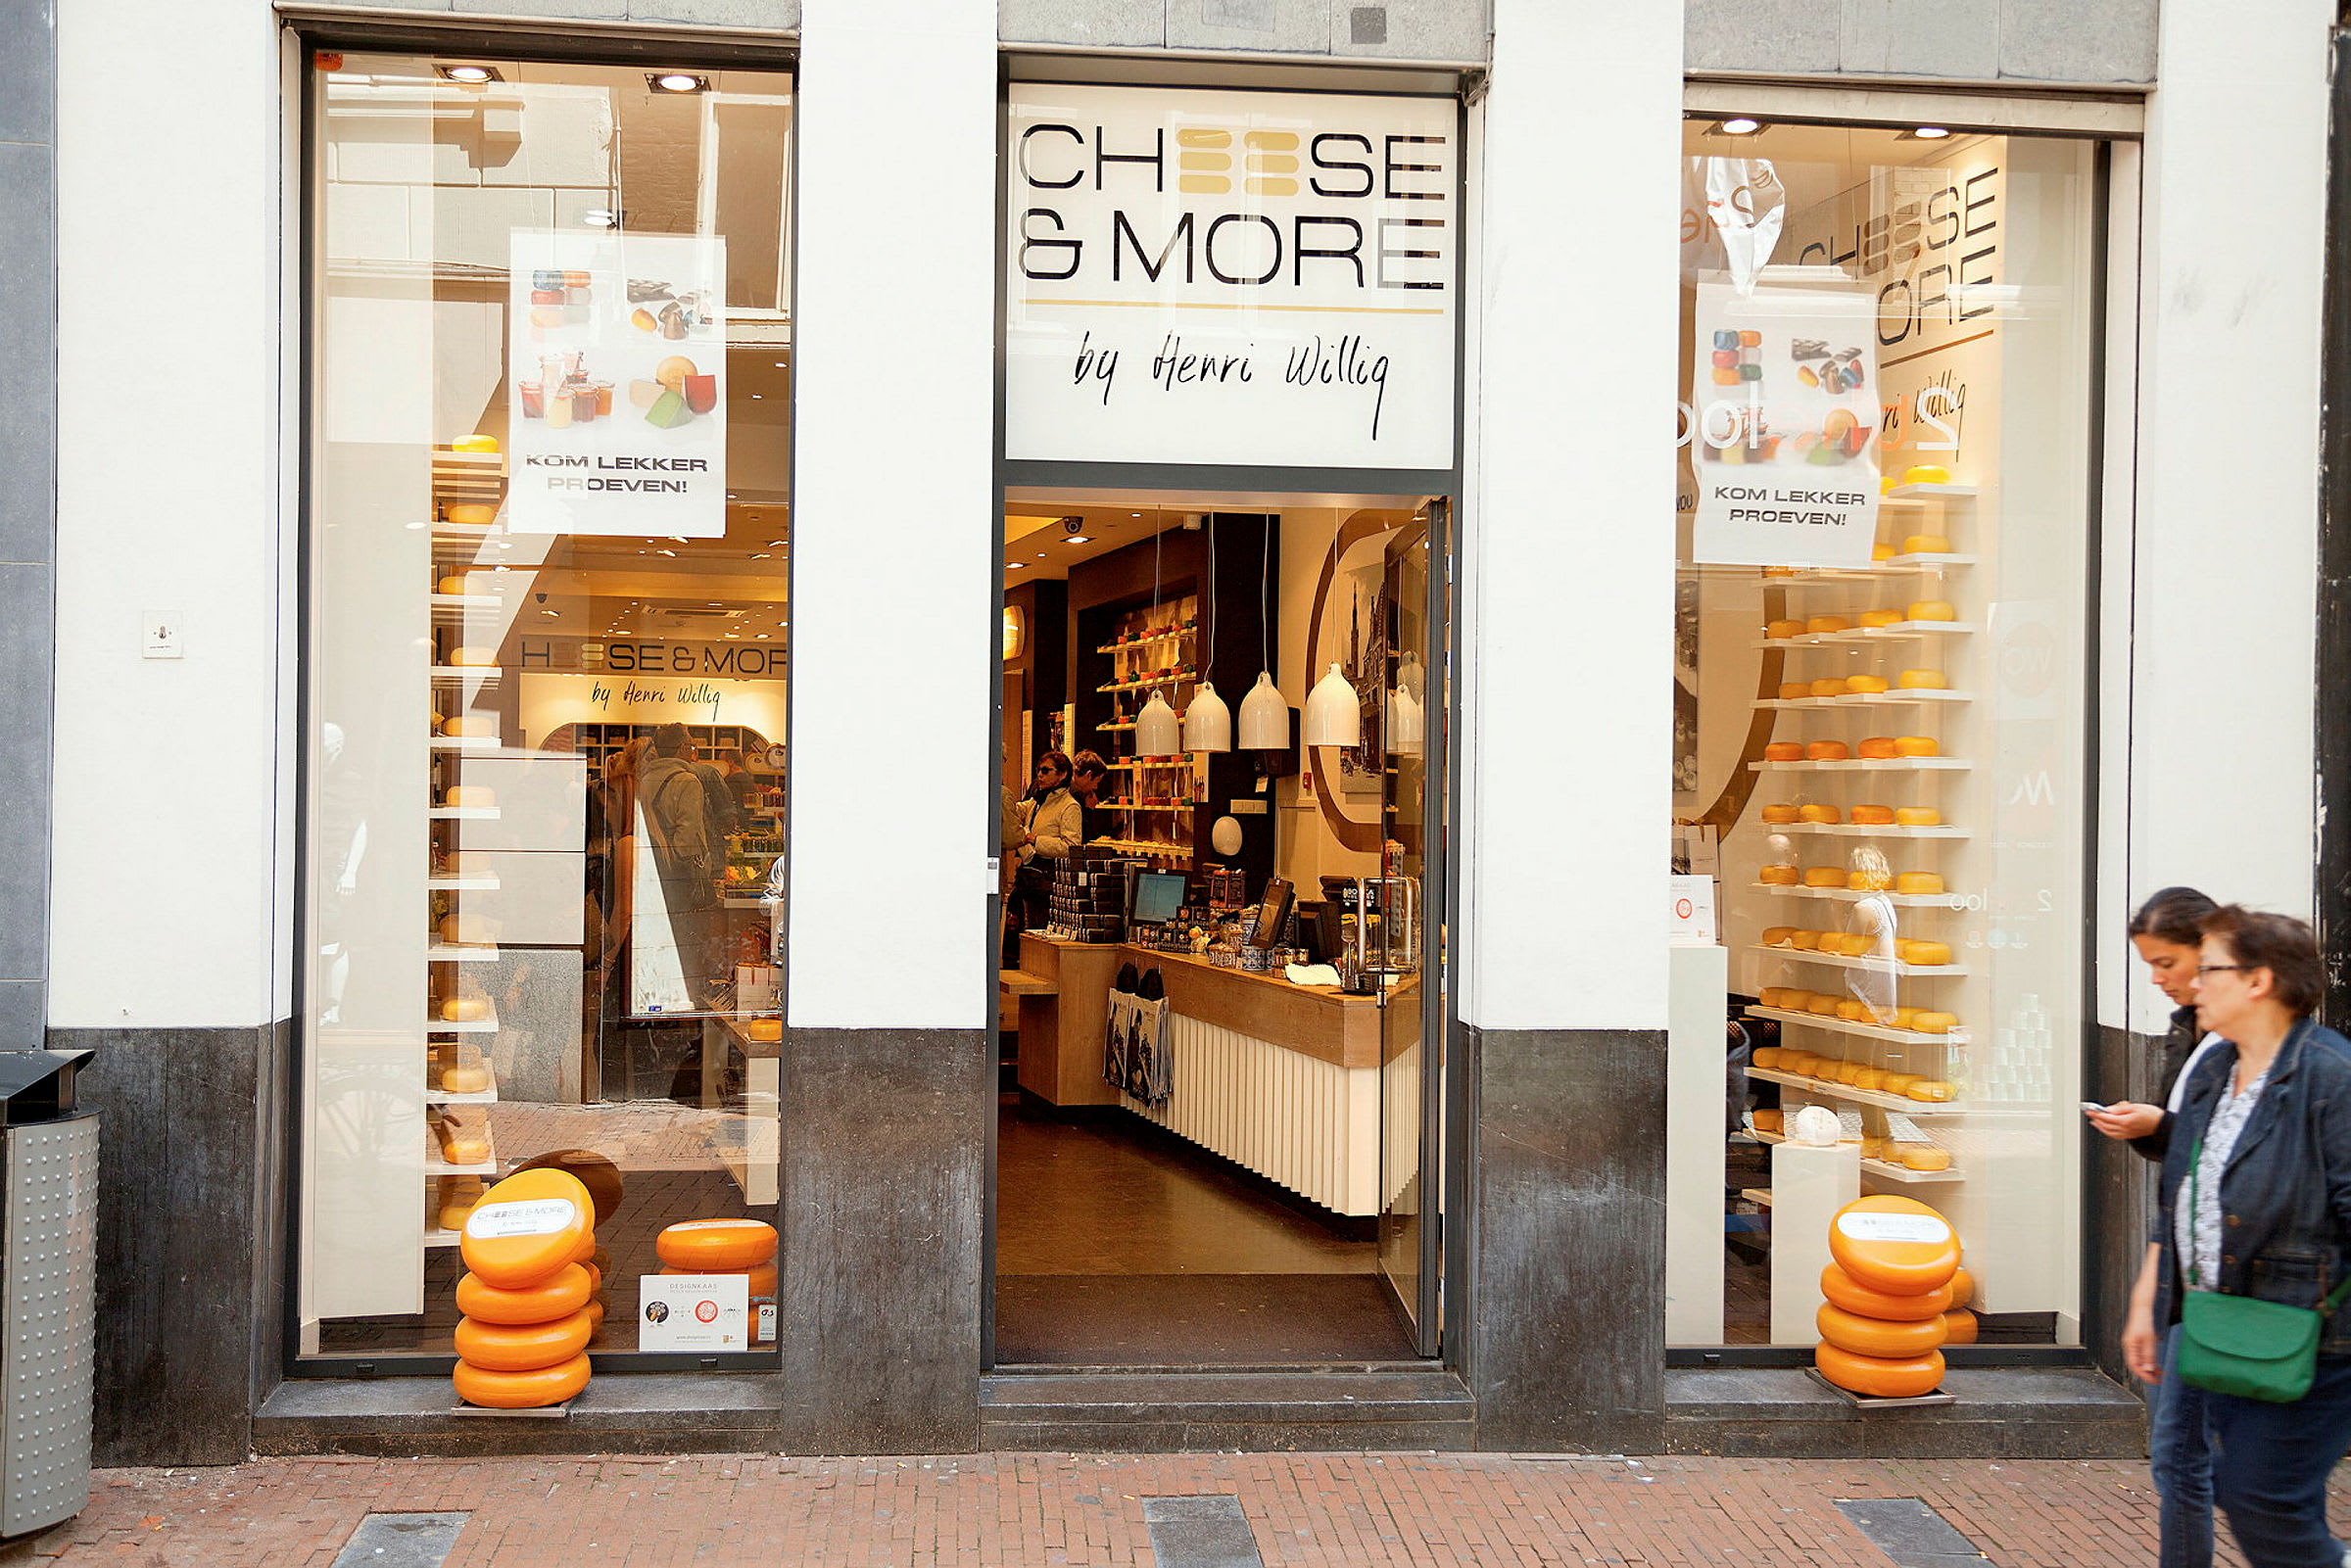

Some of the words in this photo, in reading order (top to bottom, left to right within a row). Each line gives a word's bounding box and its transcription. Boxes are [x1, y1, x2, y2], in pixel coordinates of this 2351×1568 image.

[1020, 123, 1446, 201] CHEESE
[1019, 208, 1083, 280] &
[1113, 210, 1445, 291] MORE
[1075, 330, 1119, 405] by
[1153, 329, 1255, 392] Henri
[1285, 335, 1389, 442] Willig
[526, 453, 589, 468] KOM
[597, 456, 708, 473] LEKKER
[547, 477, 689, 494] PROEVEN!
[1714, 487, 1767, 502] KOM
[1774, 489, 1866, 506] LEKKER
[1729, 508, 1847, 526] PROEVEN!
[673, 646, 696, 672] &
[592, 681, 610, 711] by
[623, 680, 666, 705] Henri
[677, 683, 721, 722] Willig
